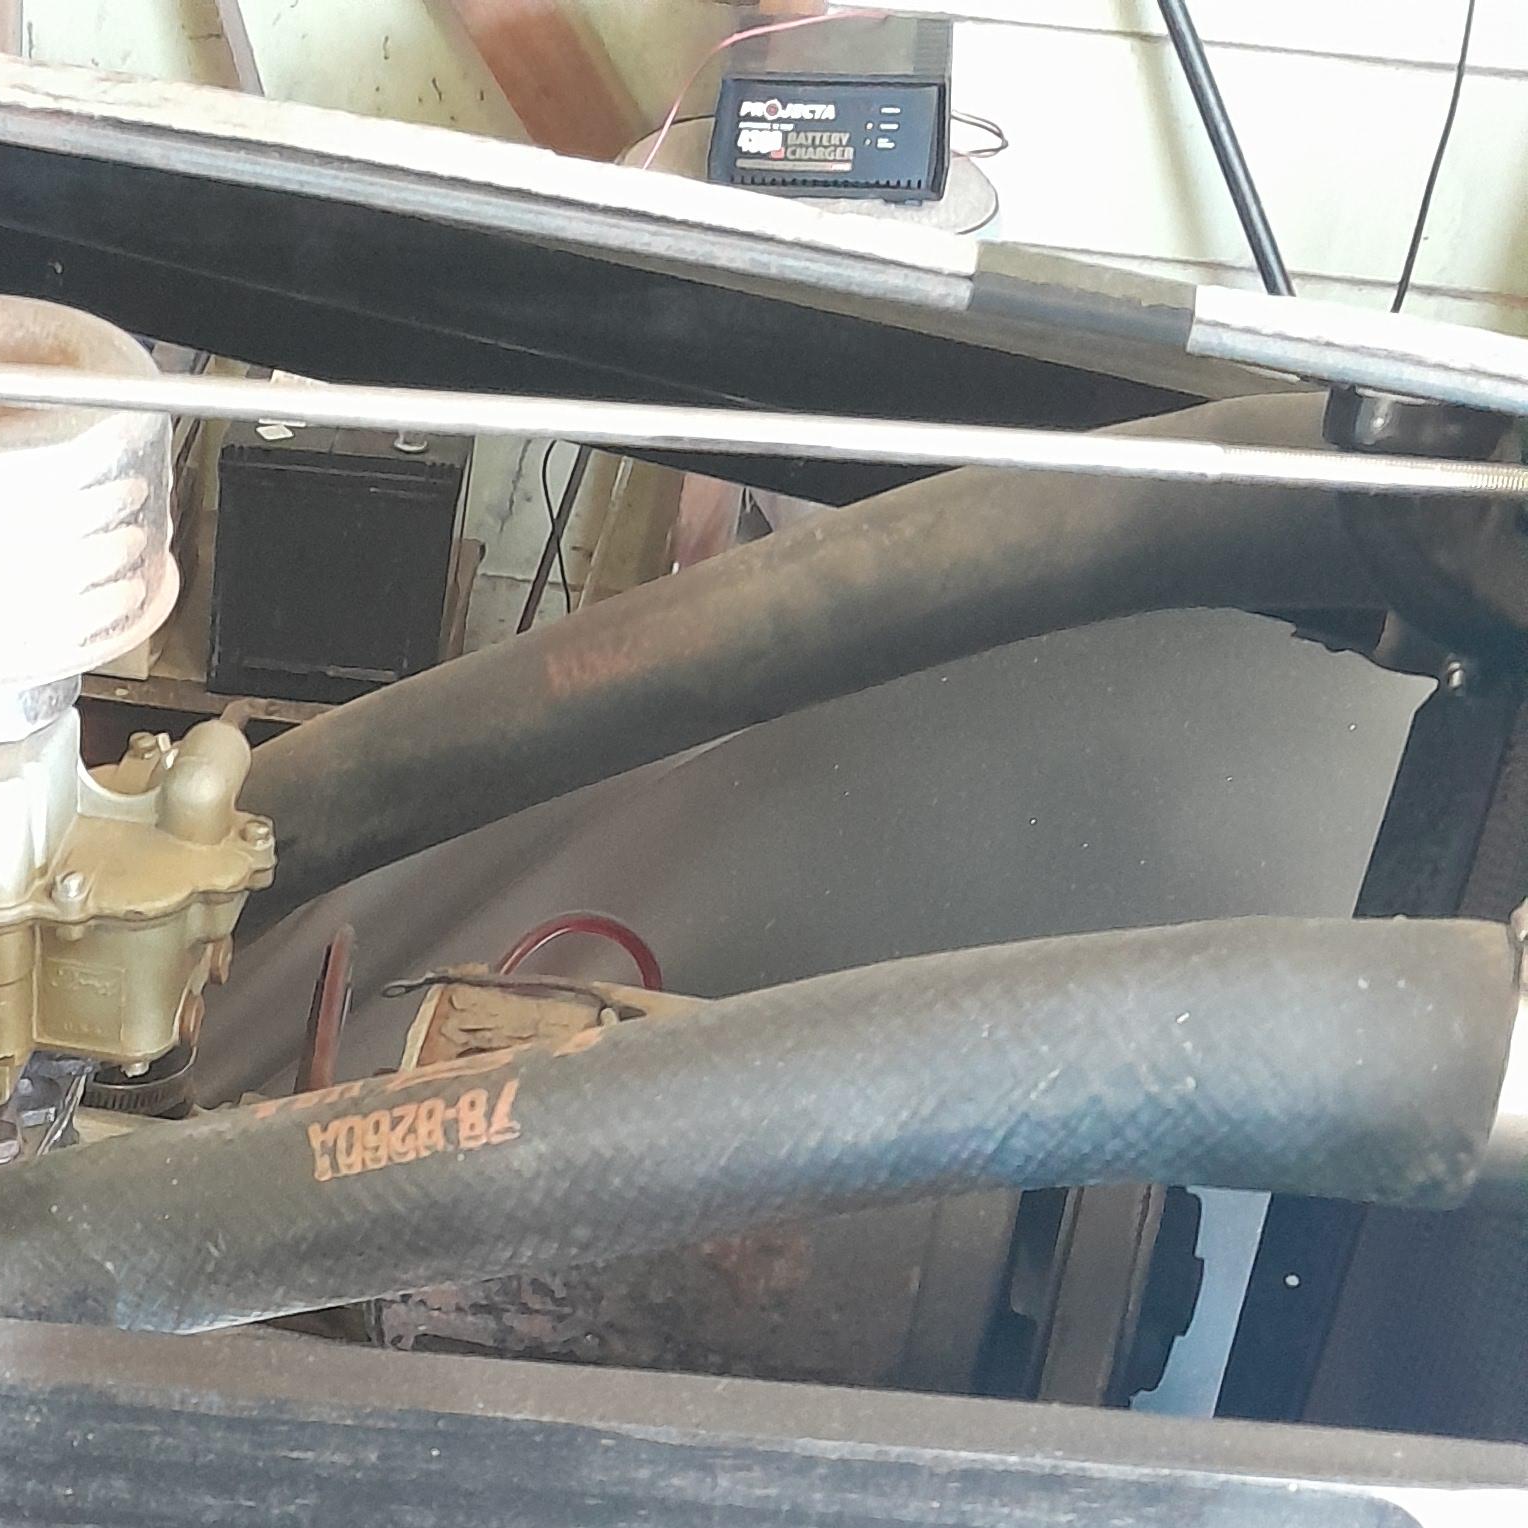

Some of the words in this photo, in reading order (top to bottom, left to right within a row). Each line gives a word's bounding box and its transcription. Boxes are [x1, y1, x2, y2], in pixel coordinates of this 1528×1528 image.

[739, 99, 835, 120] PROJECTA
[787, 131, 850, 146] BATTERY
[786, 146, 854, 160] CHARGER
